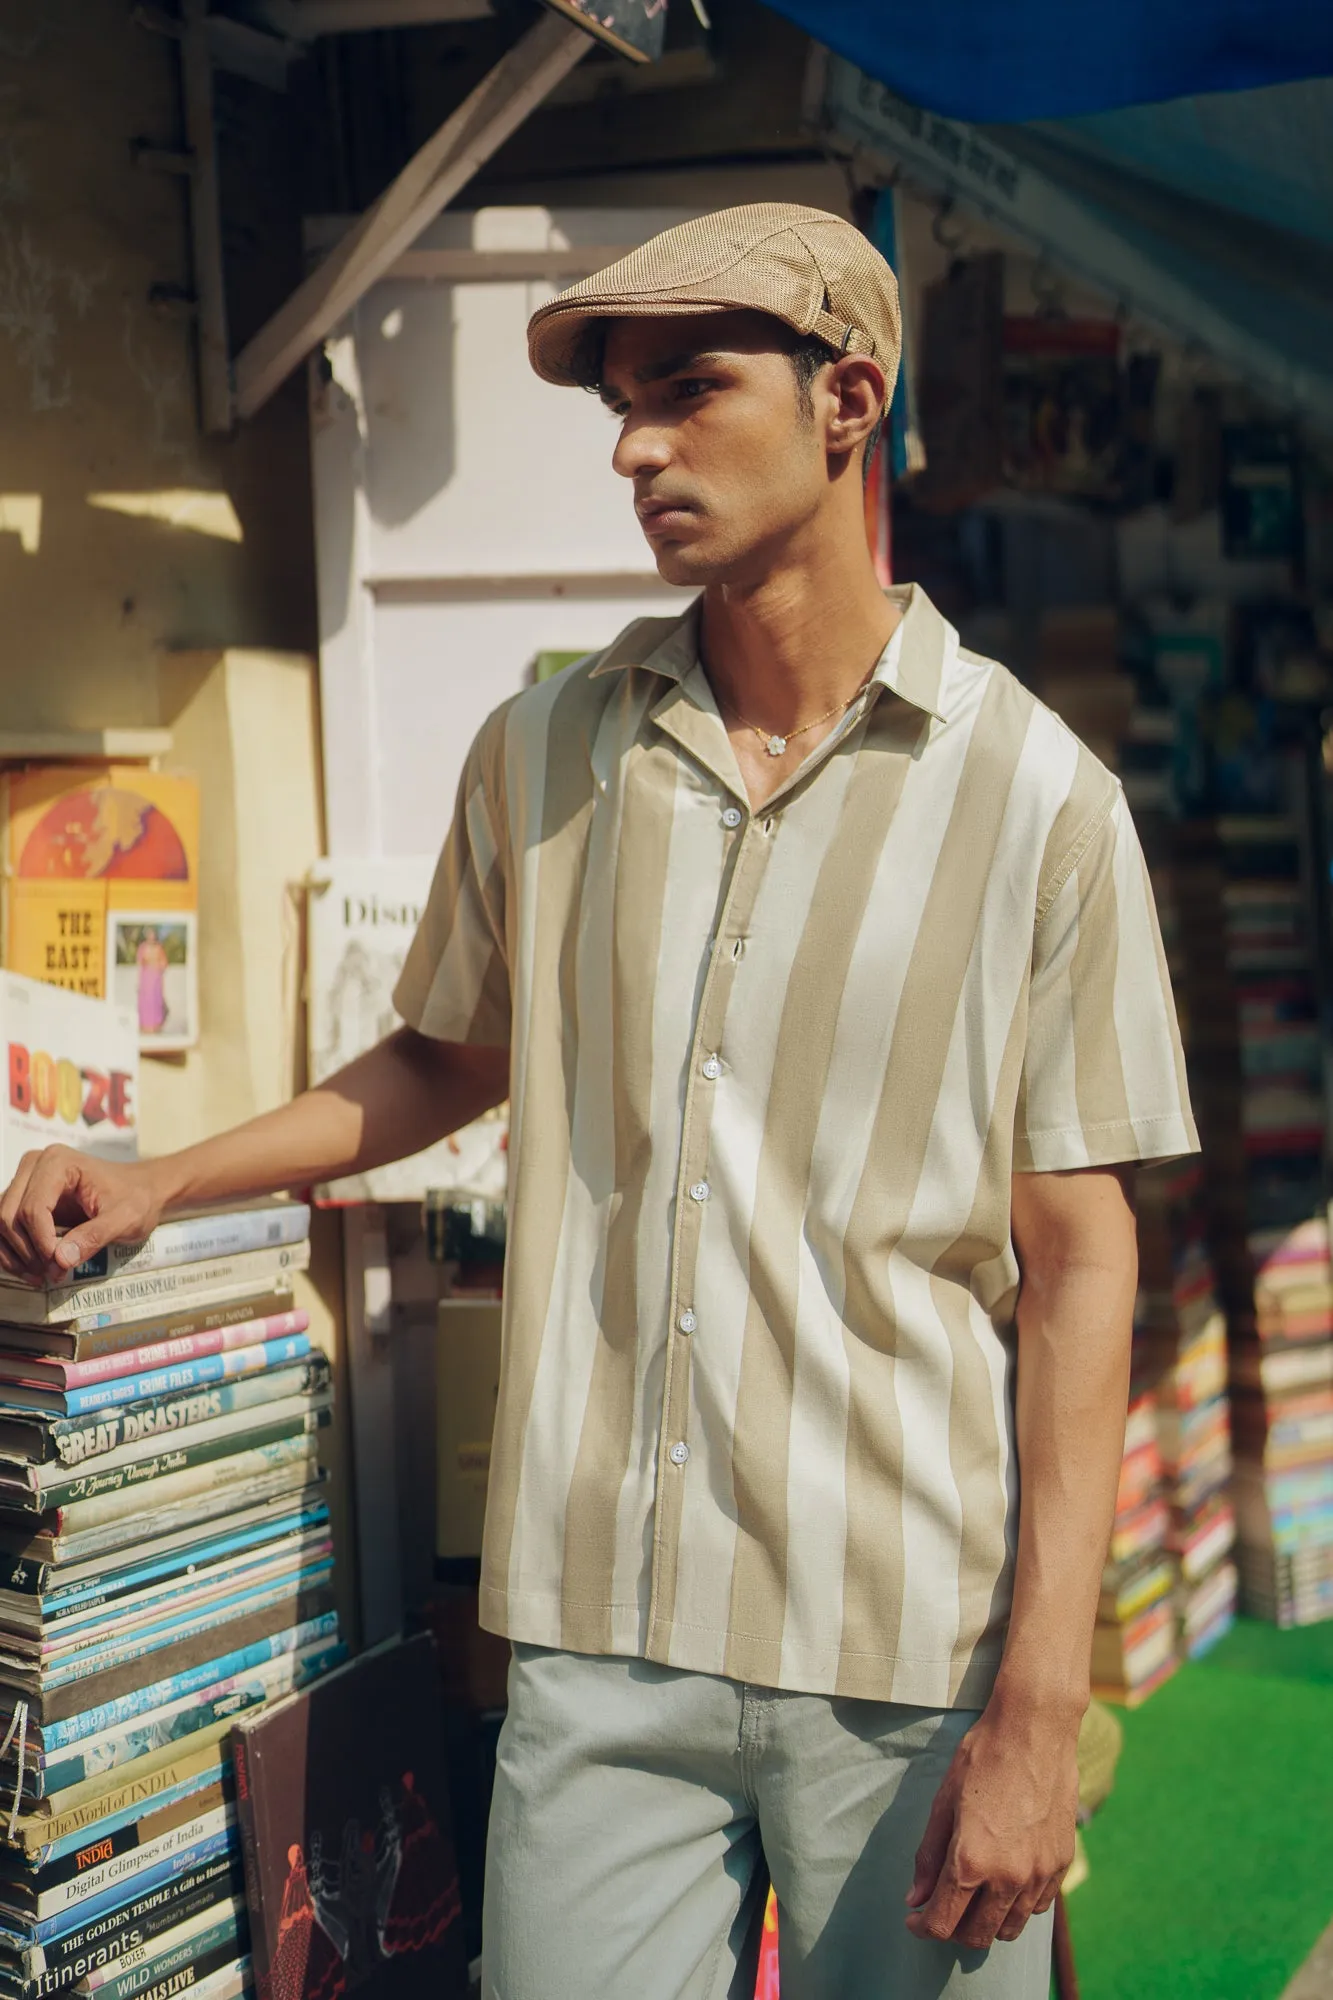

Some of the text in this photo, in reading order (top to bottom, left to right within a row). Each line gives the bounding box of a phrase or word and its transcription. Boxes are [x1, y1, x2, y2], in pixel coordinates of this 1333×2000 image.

[58, 911, 92, 936] THE
[343, 895, 418, 927] Disn
[46, 945, 91, 971] EAST
[8, 1042, 134, 1127] BOOZE
[72, 1293, 83, 1311] IN
[83, 1290, 113, 1307] SEARCH
[114, 1287, 124, 1301] OF
[125, 1275, 178, 1300] SHAKESPEARE
[225, 1307, 254, 1323] NANDA
[79, 1359, 110, 1376] READER'S
[110, 1354, 134, 1370] DIGEST
[137, 1345, 167, 1363] CRIME
[169, 1337, 194, 1356] FILES
[80, 1390, 111, 1408] READER'S
[112, 1384, 135, 1402] DIGEST
[139, 1375, 168, 1396] CRIME
[169, 1368, 194, 1387] FILES
[57, 1392, 222, 1464] GREAT DISASTERS
[69, 1450, 187, 1498] A Journey Through India
[75, 1647, 146, 1678] UDAIPUR
[44, 1820, 72, 1840] The
[73, 1801, 111, 1826] World
[113, 1791, 127, 1809] of
[131, 1769, 178, 1803] INDIA
[66, 1873, 105, 1900] Digital
[109, 1847, 161, 1877] Glimpses
[162, 1838, 174, 1852] of
[177, 1823, 204, 1846] India
[76, 1840, 114, 1870] INDIA
[172, 1852, 196, 1870] India
[62, 1934, 84, 1954] THE
[86, 1910, 130, 1941] GOLDEN
[131, 1885, 171, 1917] TEMPLE
[173, 1882, 180, 1896] A
[180, 1876, 195, 1893] Gift
[196, 1872, 206, 1885] to
[36, 1928, 141, 1999] Itinerants
[186, 1891, 215, 1913] nomads
[119, 1947, 146, 1969] BOXER
[116, 1967, 150, 1997] WILD
[153, 1946, 193, 1974] WONDERS
[167, 1966, 196, 1991] LIVE
